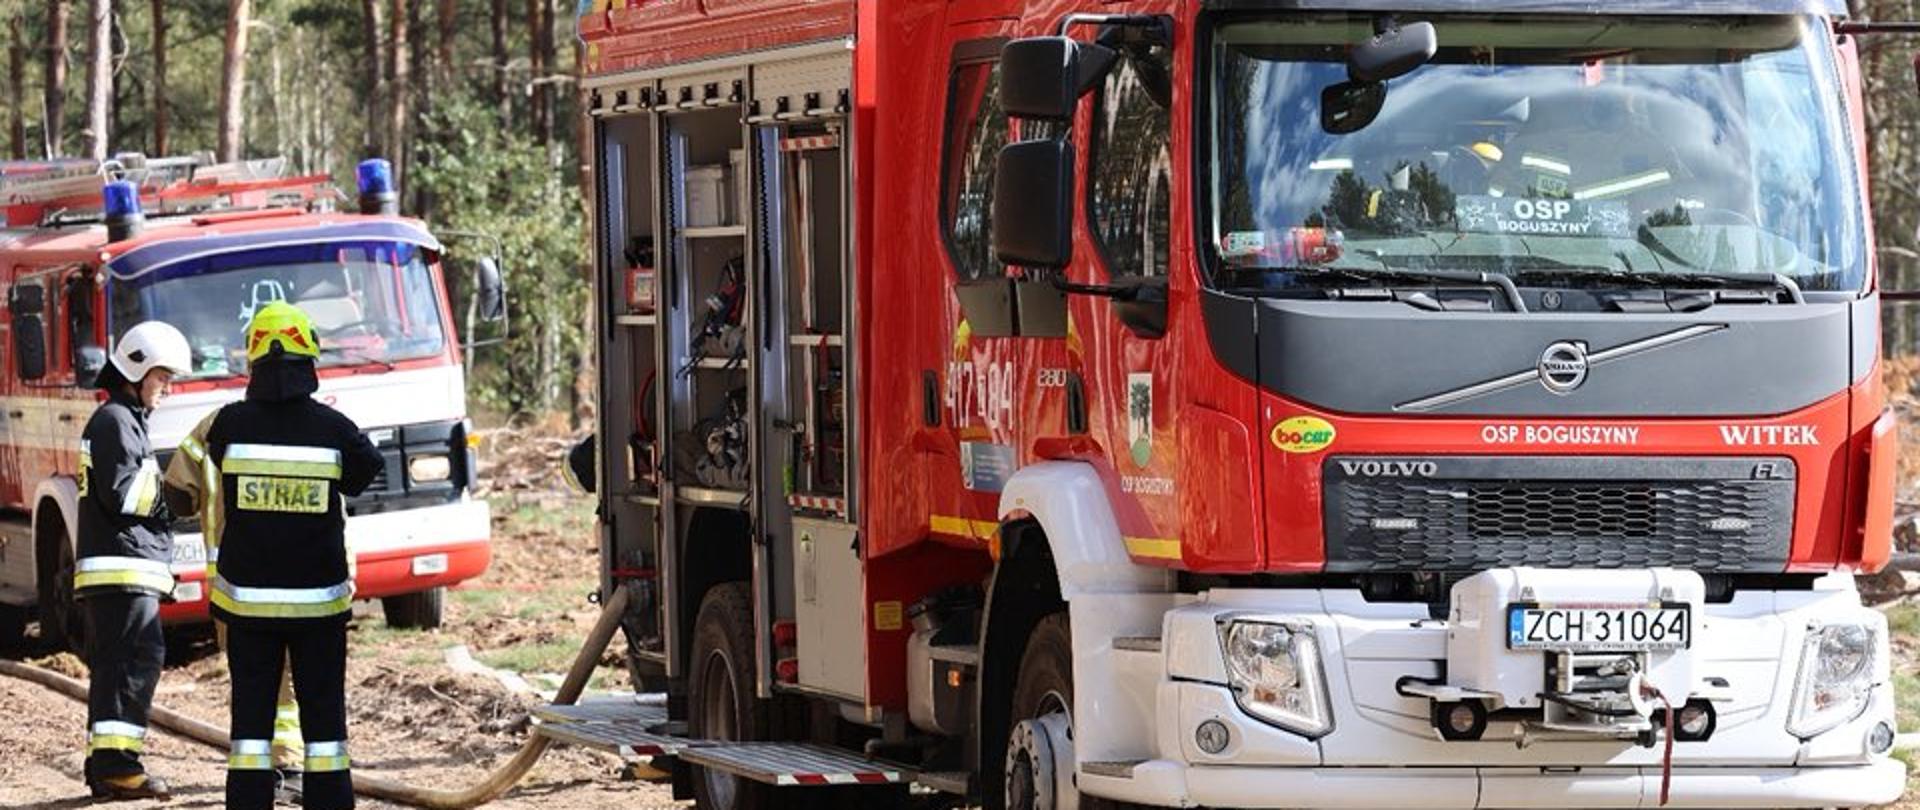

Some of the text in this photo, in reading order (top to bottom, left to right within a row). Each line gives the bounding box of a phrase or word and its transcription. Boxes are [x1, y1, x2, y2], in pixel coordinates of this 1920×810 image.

[1513, 200, 1571, 220] OSP
[1499, 220, 1592, 233] BOGUSZYNY
[1276, 428, 1333, 444] bocar
[1481, 425, 1640, 444] OSP BOGUSZYNY
[1719, 425, 1820, 445] WITEK
[1338, 460, 1438, 477] VOLVO
[1527, 610, 1685, 642] ZCH 31064
